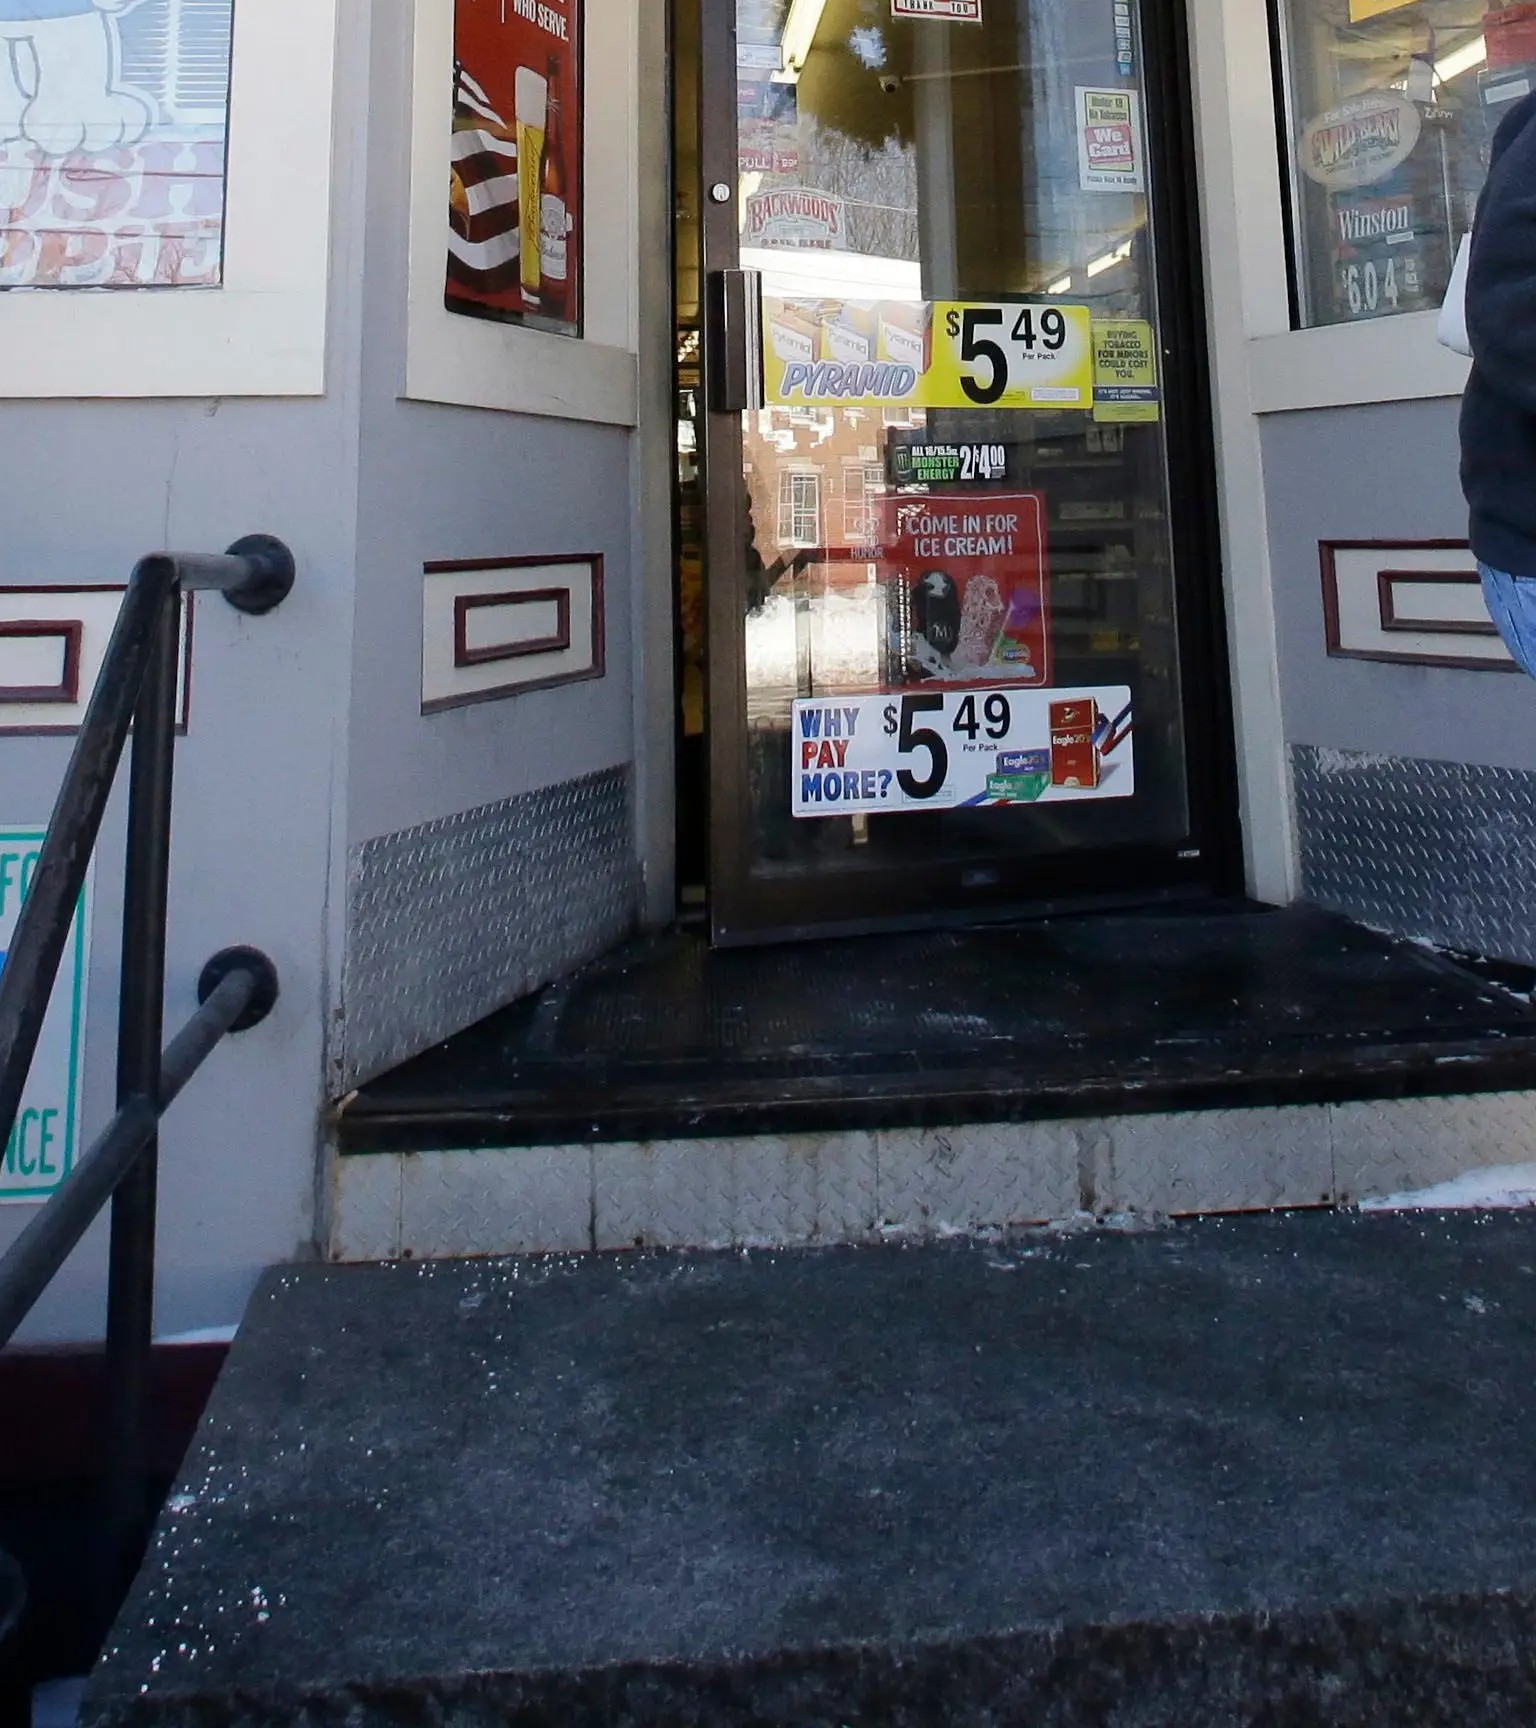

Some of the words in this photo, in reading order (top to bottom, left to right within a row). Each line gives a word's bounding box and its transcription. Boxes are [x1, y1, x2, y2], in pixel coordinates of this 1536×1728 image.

[950, 2, 969, 14] YOU
[537, 3, 569, 43] SERVE.
[1093, 128, 1124, 143] We
[1088, 142, 1131, 158] Card
[750, 192, 840, 235] BACKWOODS
[1337, 205, 1409, 242] Winston
[1106, 330, 1137, 340] BUYING
[1103, 339, 1141, 349] TOBACCO
[1022, 352, 1037, 361] Per
[1037, 352, 1056, 361] Pack
[1098, 350, 1115, 359] FOR
[1099, 359, 1126, 369] COULD
[1128, 359, 1148, 368] COST
[780, 361, 917, 398] PYRAMID
[911, 446, 924, 456] ALL
[911, 457, 959, 468] MONSTER
[917, 468, 955, 480] ENERGY
[907, 516, 958, 536] COME
[986, 514, 1018, 533] FOR
[850, 546, 885, 560] HUMOR
[914, 538, 940, 557] ICE
[944, 535, 1014, 557] CREAM!
[799, 706, 861, 738] WHY
[801, 739, 850, 770] PAY
[963, 743, 977, 753] Per
[978, 742, 999, 752] Pack
[801, 768, 894, 803] MORE?
